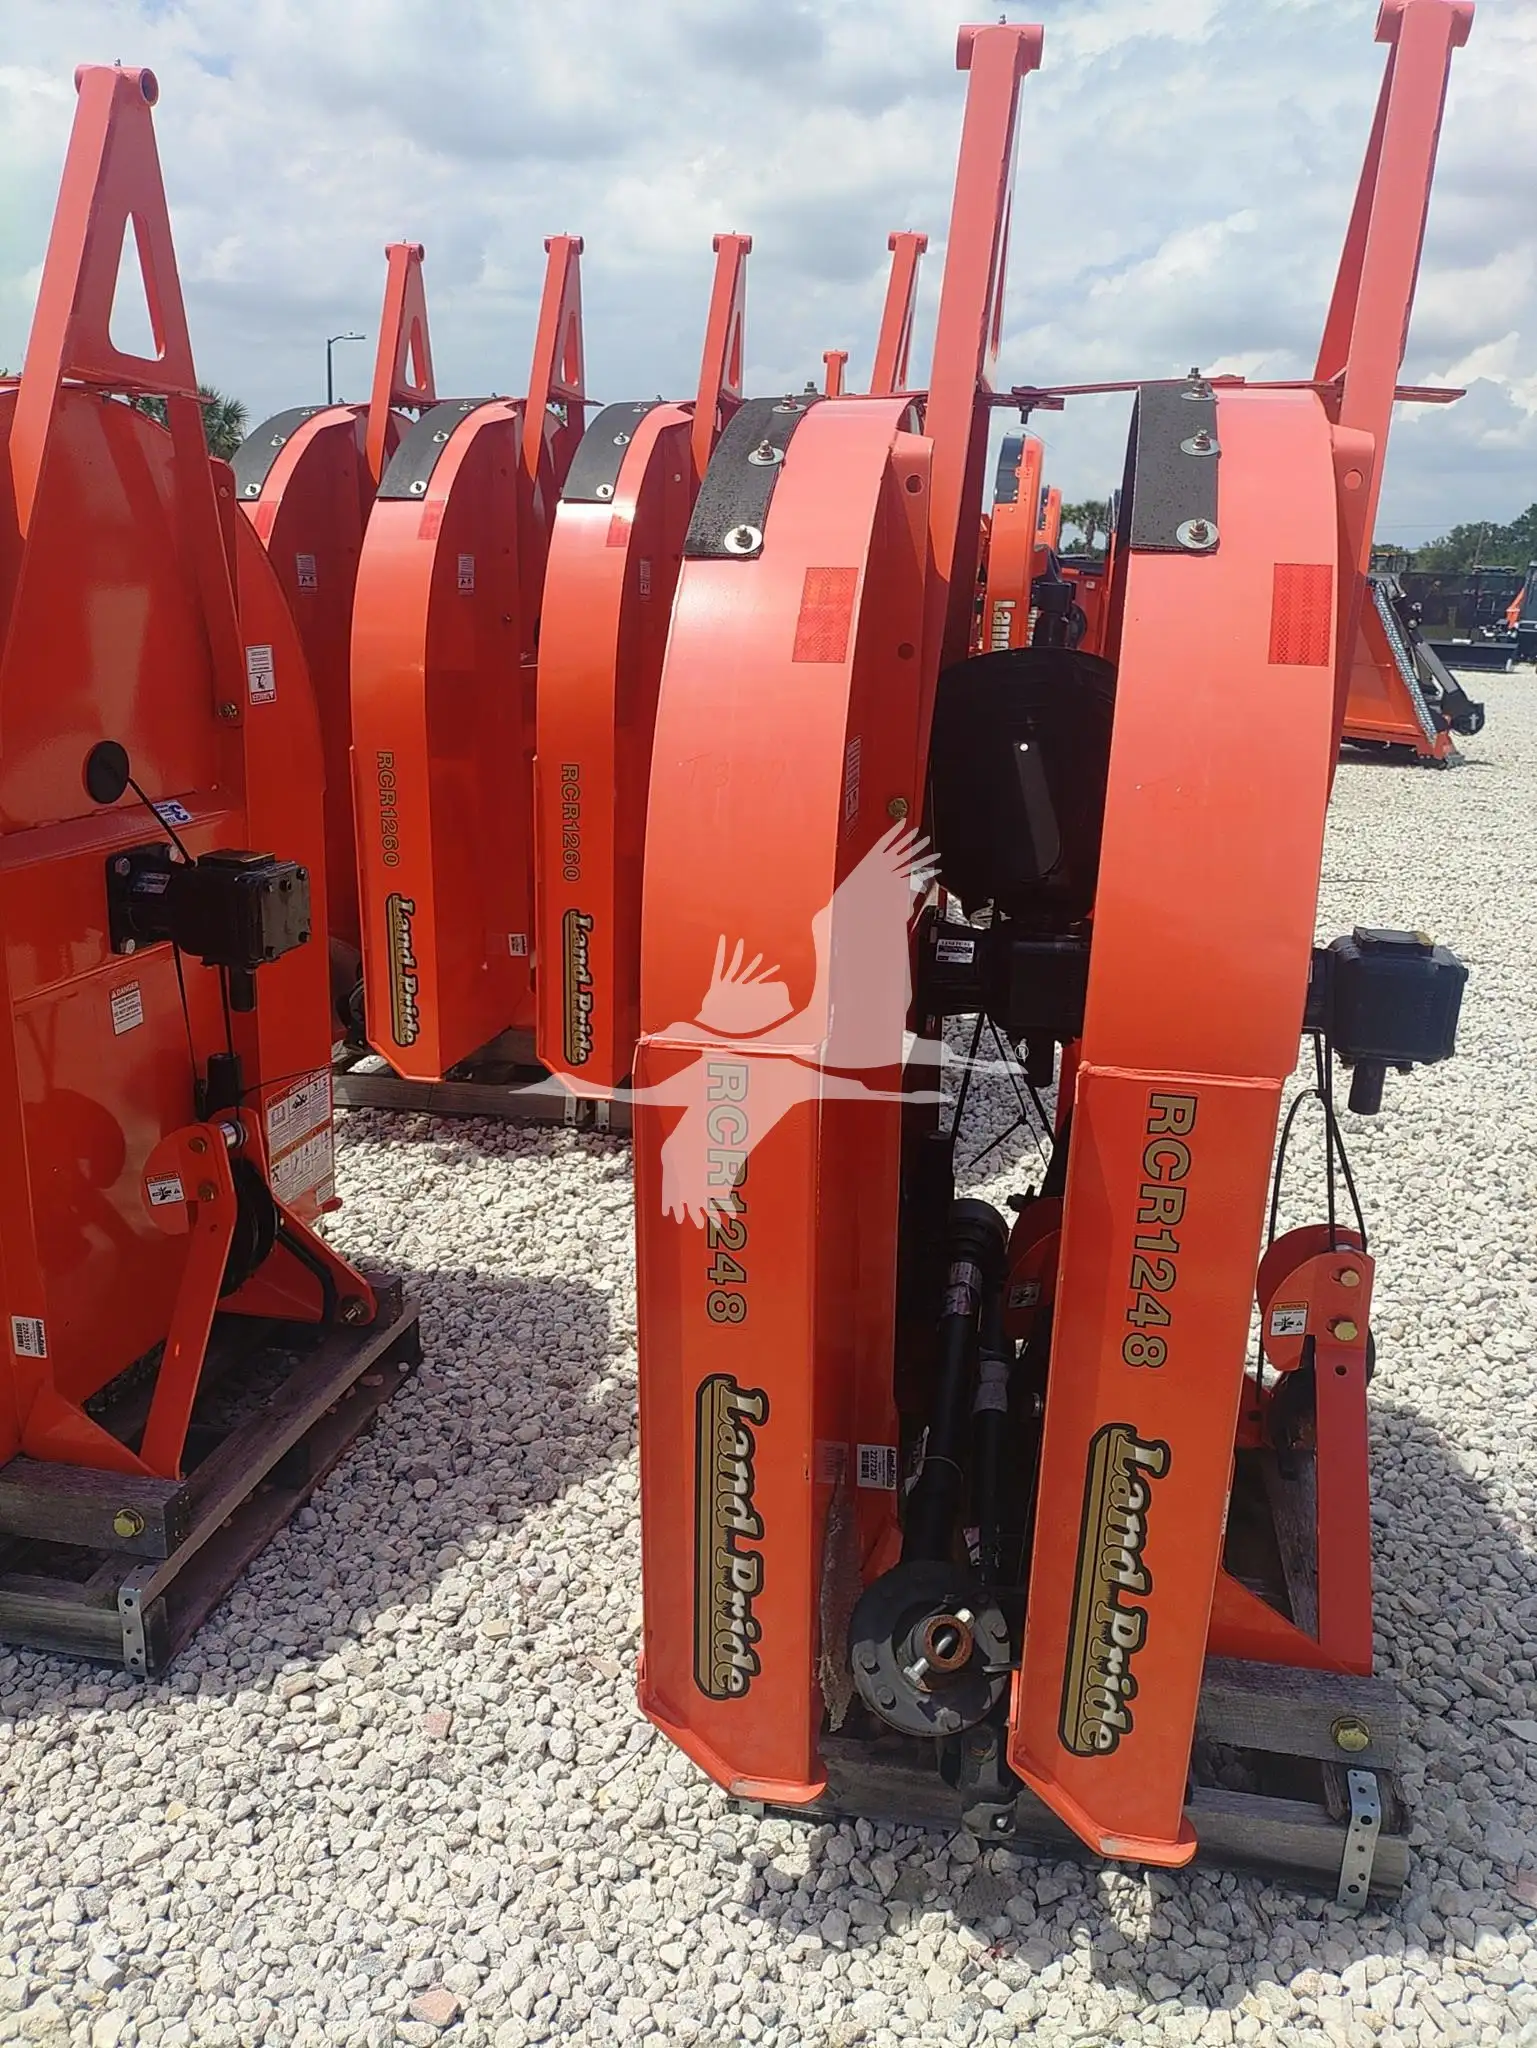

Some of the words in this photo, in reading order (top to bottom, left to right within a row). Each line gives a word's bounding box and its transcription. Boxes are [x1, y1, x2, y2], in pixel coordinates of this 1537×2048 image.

[377, 751, 400, 867] RCR1260
[561, 763, 581, 881] RCR1260
[396, 896, 416, 970] Land
[571, 911, 594, 988] Land
[398, 974, 421, 1045] Pride
[570, 990, 594, 1064] Pride
[707, 1062, 749, 1324] RCR1248
[1122, 1093, 1198, 1369] RCR1248
[715, 1382, 768, 1543] Land
[1101, 1433, 1170, 1595] Land
[711, 1545, 765, 1697] Pride
[1077, 1600, 1149, 1750] Pride
